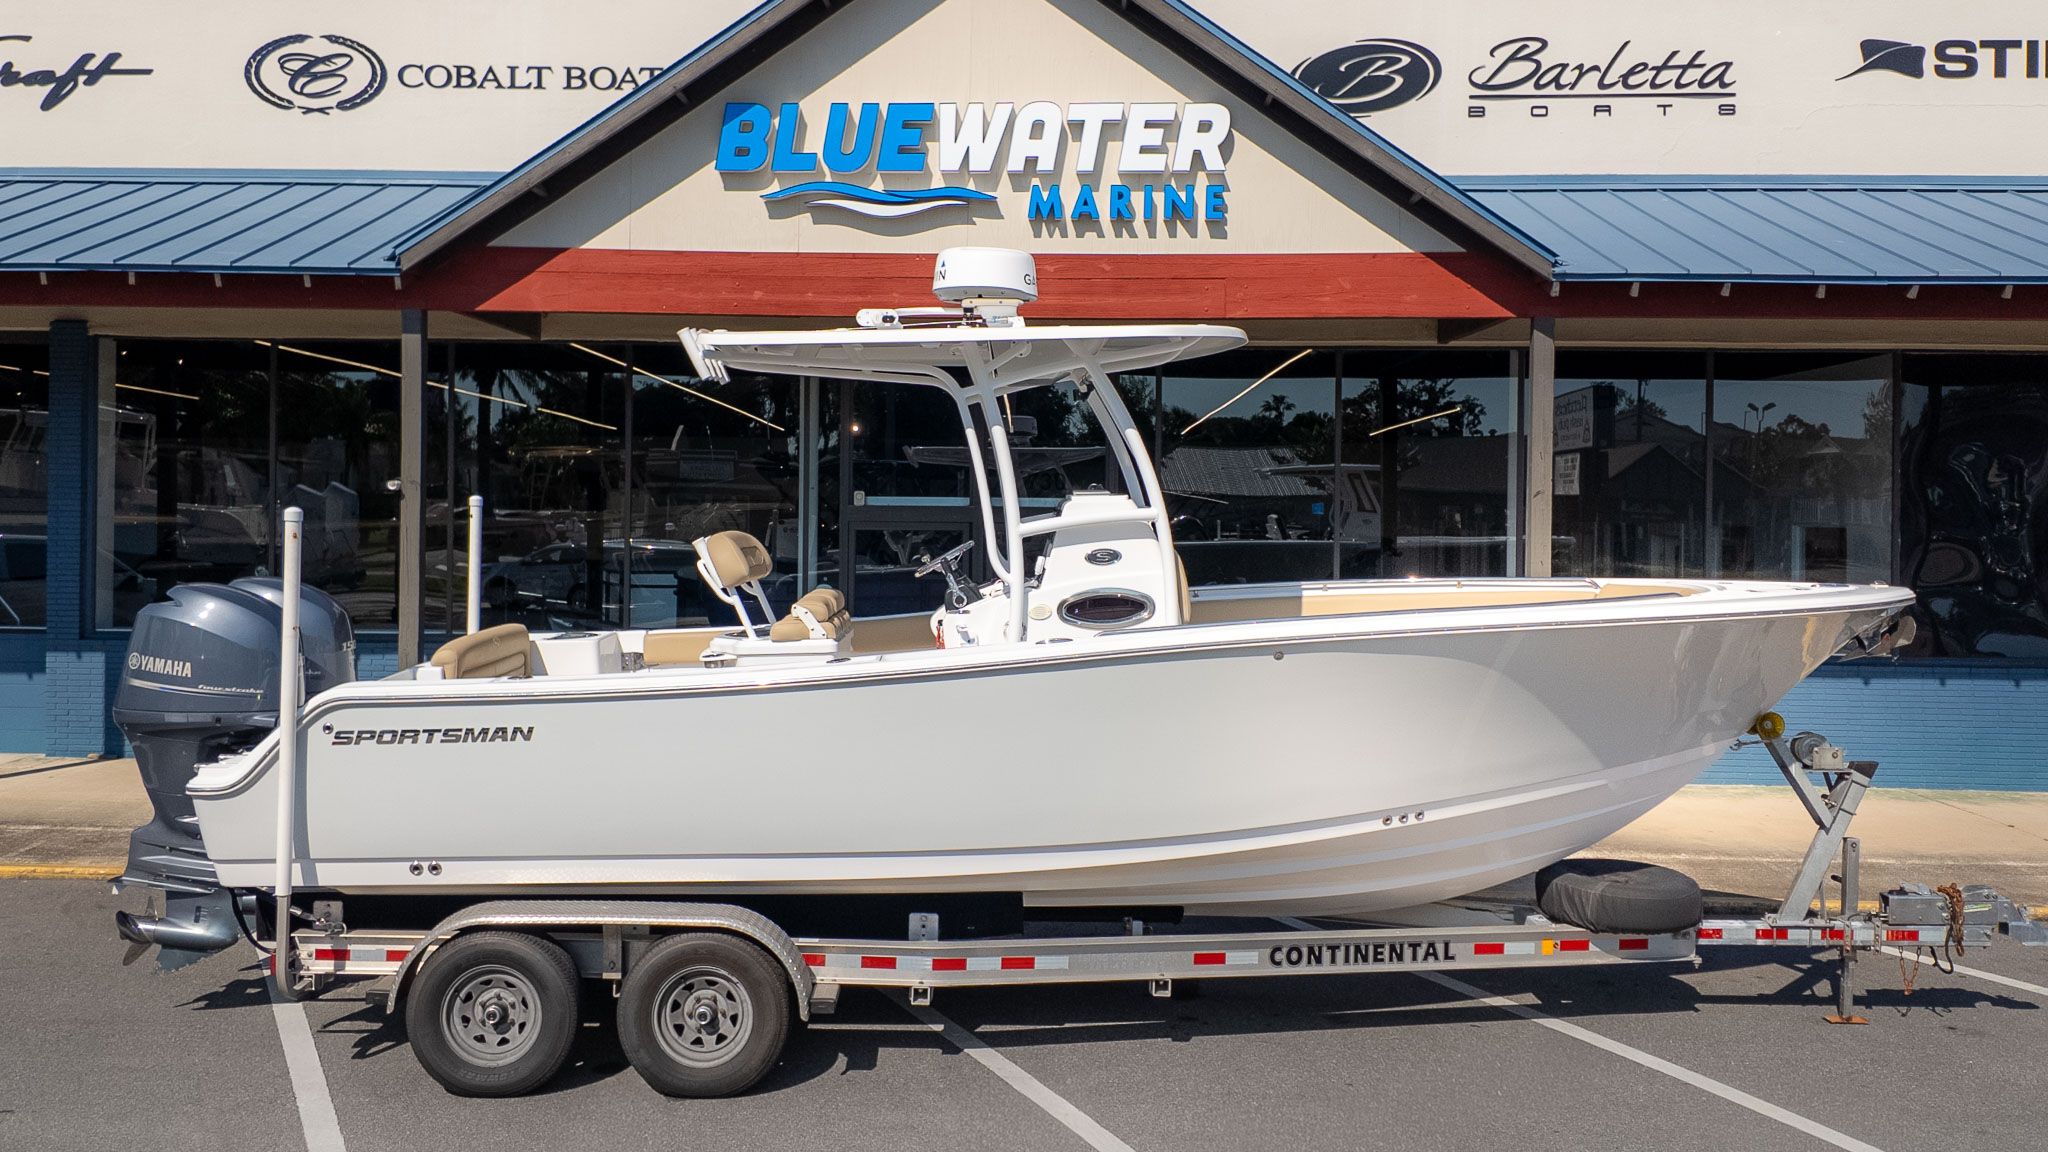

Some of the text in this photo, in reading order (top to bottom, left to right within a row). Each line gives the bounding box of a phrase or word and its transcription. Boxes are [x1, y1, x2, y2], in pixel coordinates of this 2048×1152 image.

[0, 35, 154, 112] raft
[1468, 36, 1737, 92] Barletta
[1934, 38, 2048, 80] STI
[397, 63, 664, 91] COBALT BOAT
[1467, 103, 1737, 118] BOATS
[714, 101, 1233, 175] BLUEWATER
[1027, 183, 1227, 222] MARINE
[140, 654, 192, 678] YAMAHA
[331, 726, 535, 746] SPORTSMAN
[1268, 940, 1457, 968] CONTINENTAL
